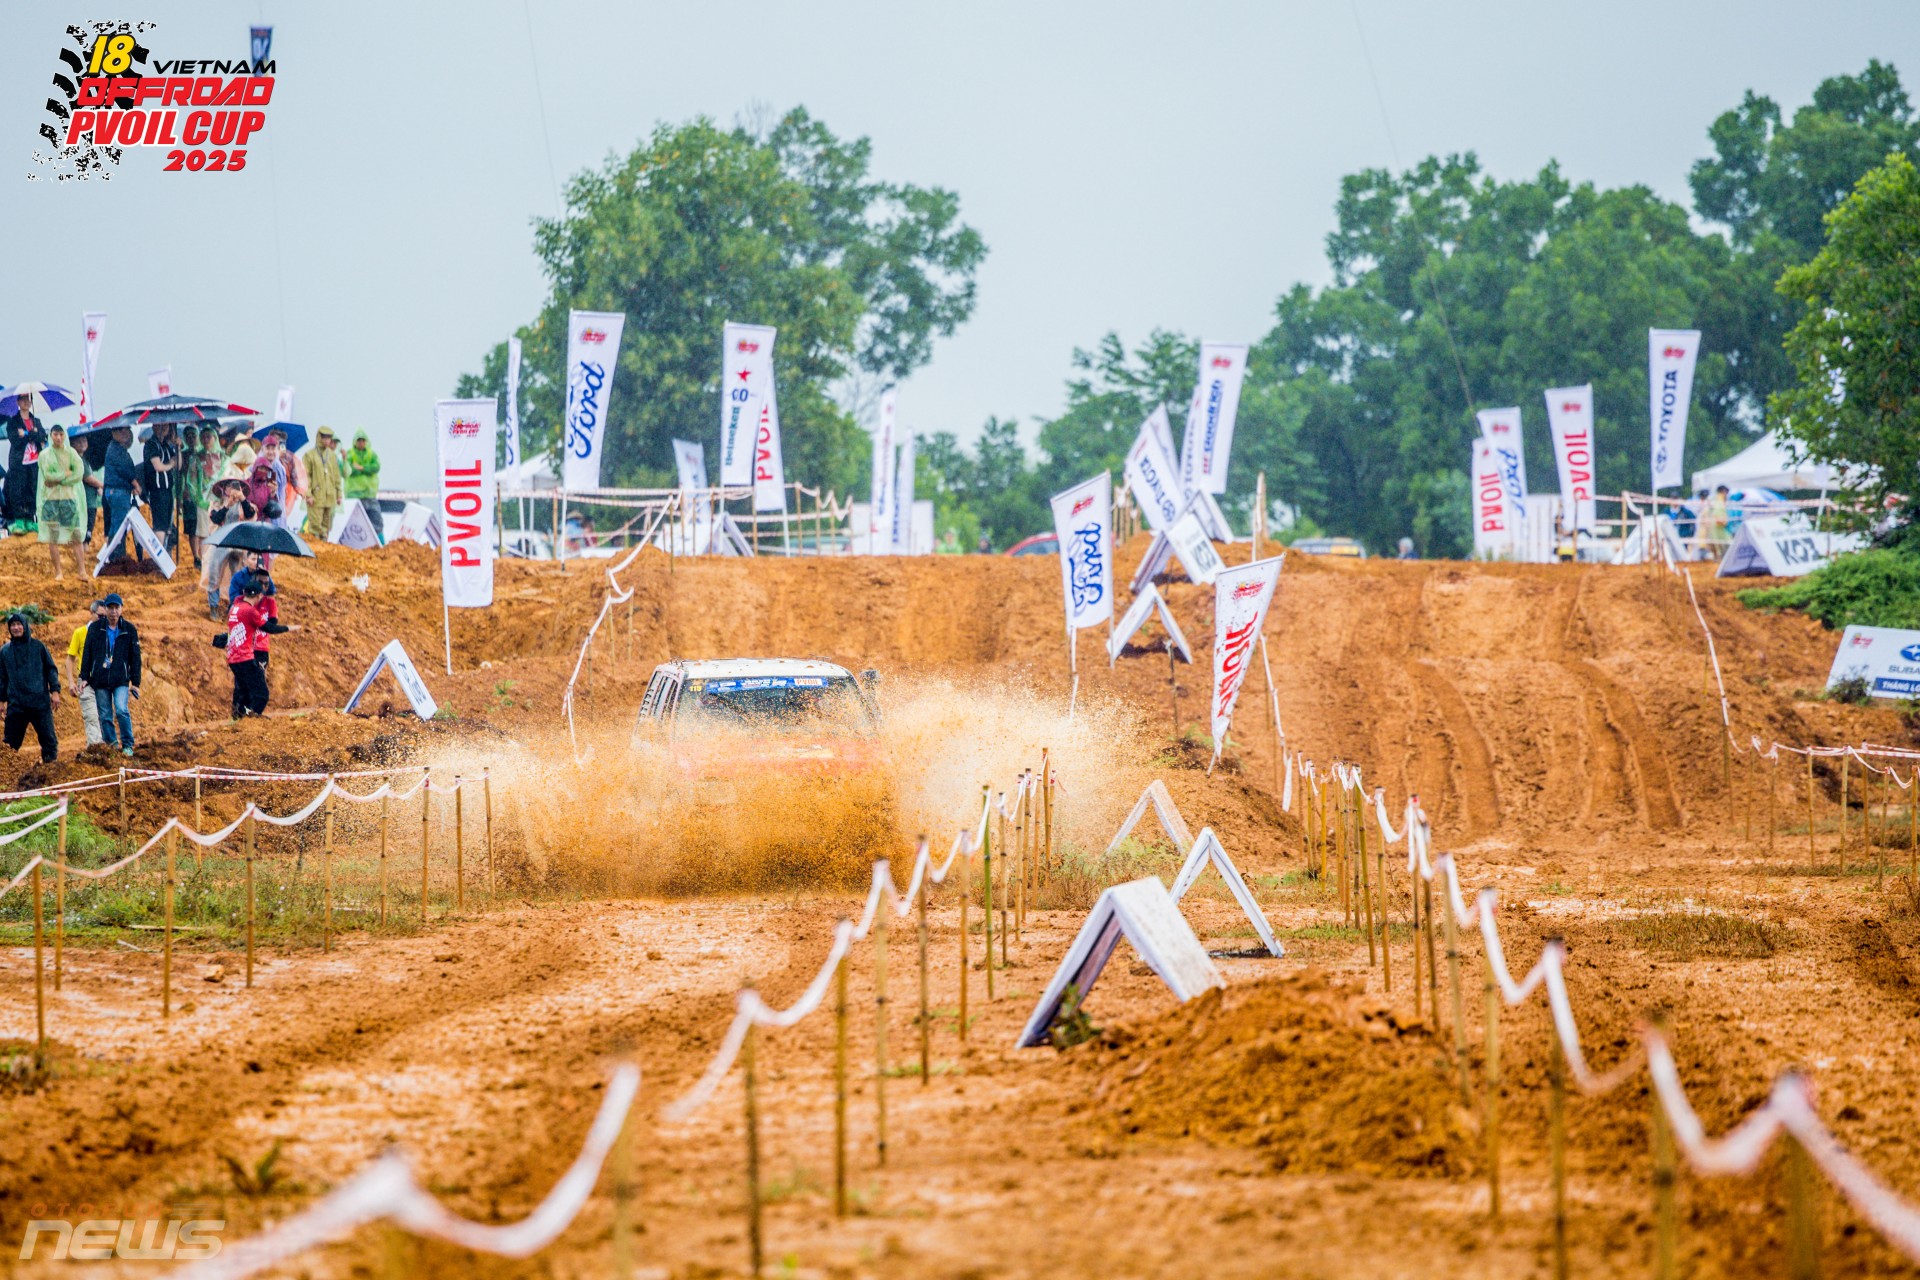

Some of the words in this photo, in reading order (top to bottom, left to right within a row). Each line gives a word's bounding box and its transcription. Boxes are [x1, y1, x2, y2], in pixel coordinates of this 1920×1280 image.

[568, 361, 605, 459] Ford
[1658, 370, 1677, 443] TOYOTA
[1564, 429, 1592, 501] PVOIL
[445, 460, 482, 567] PVOIL
[1480, 473, 1505, 533] PVOIL
